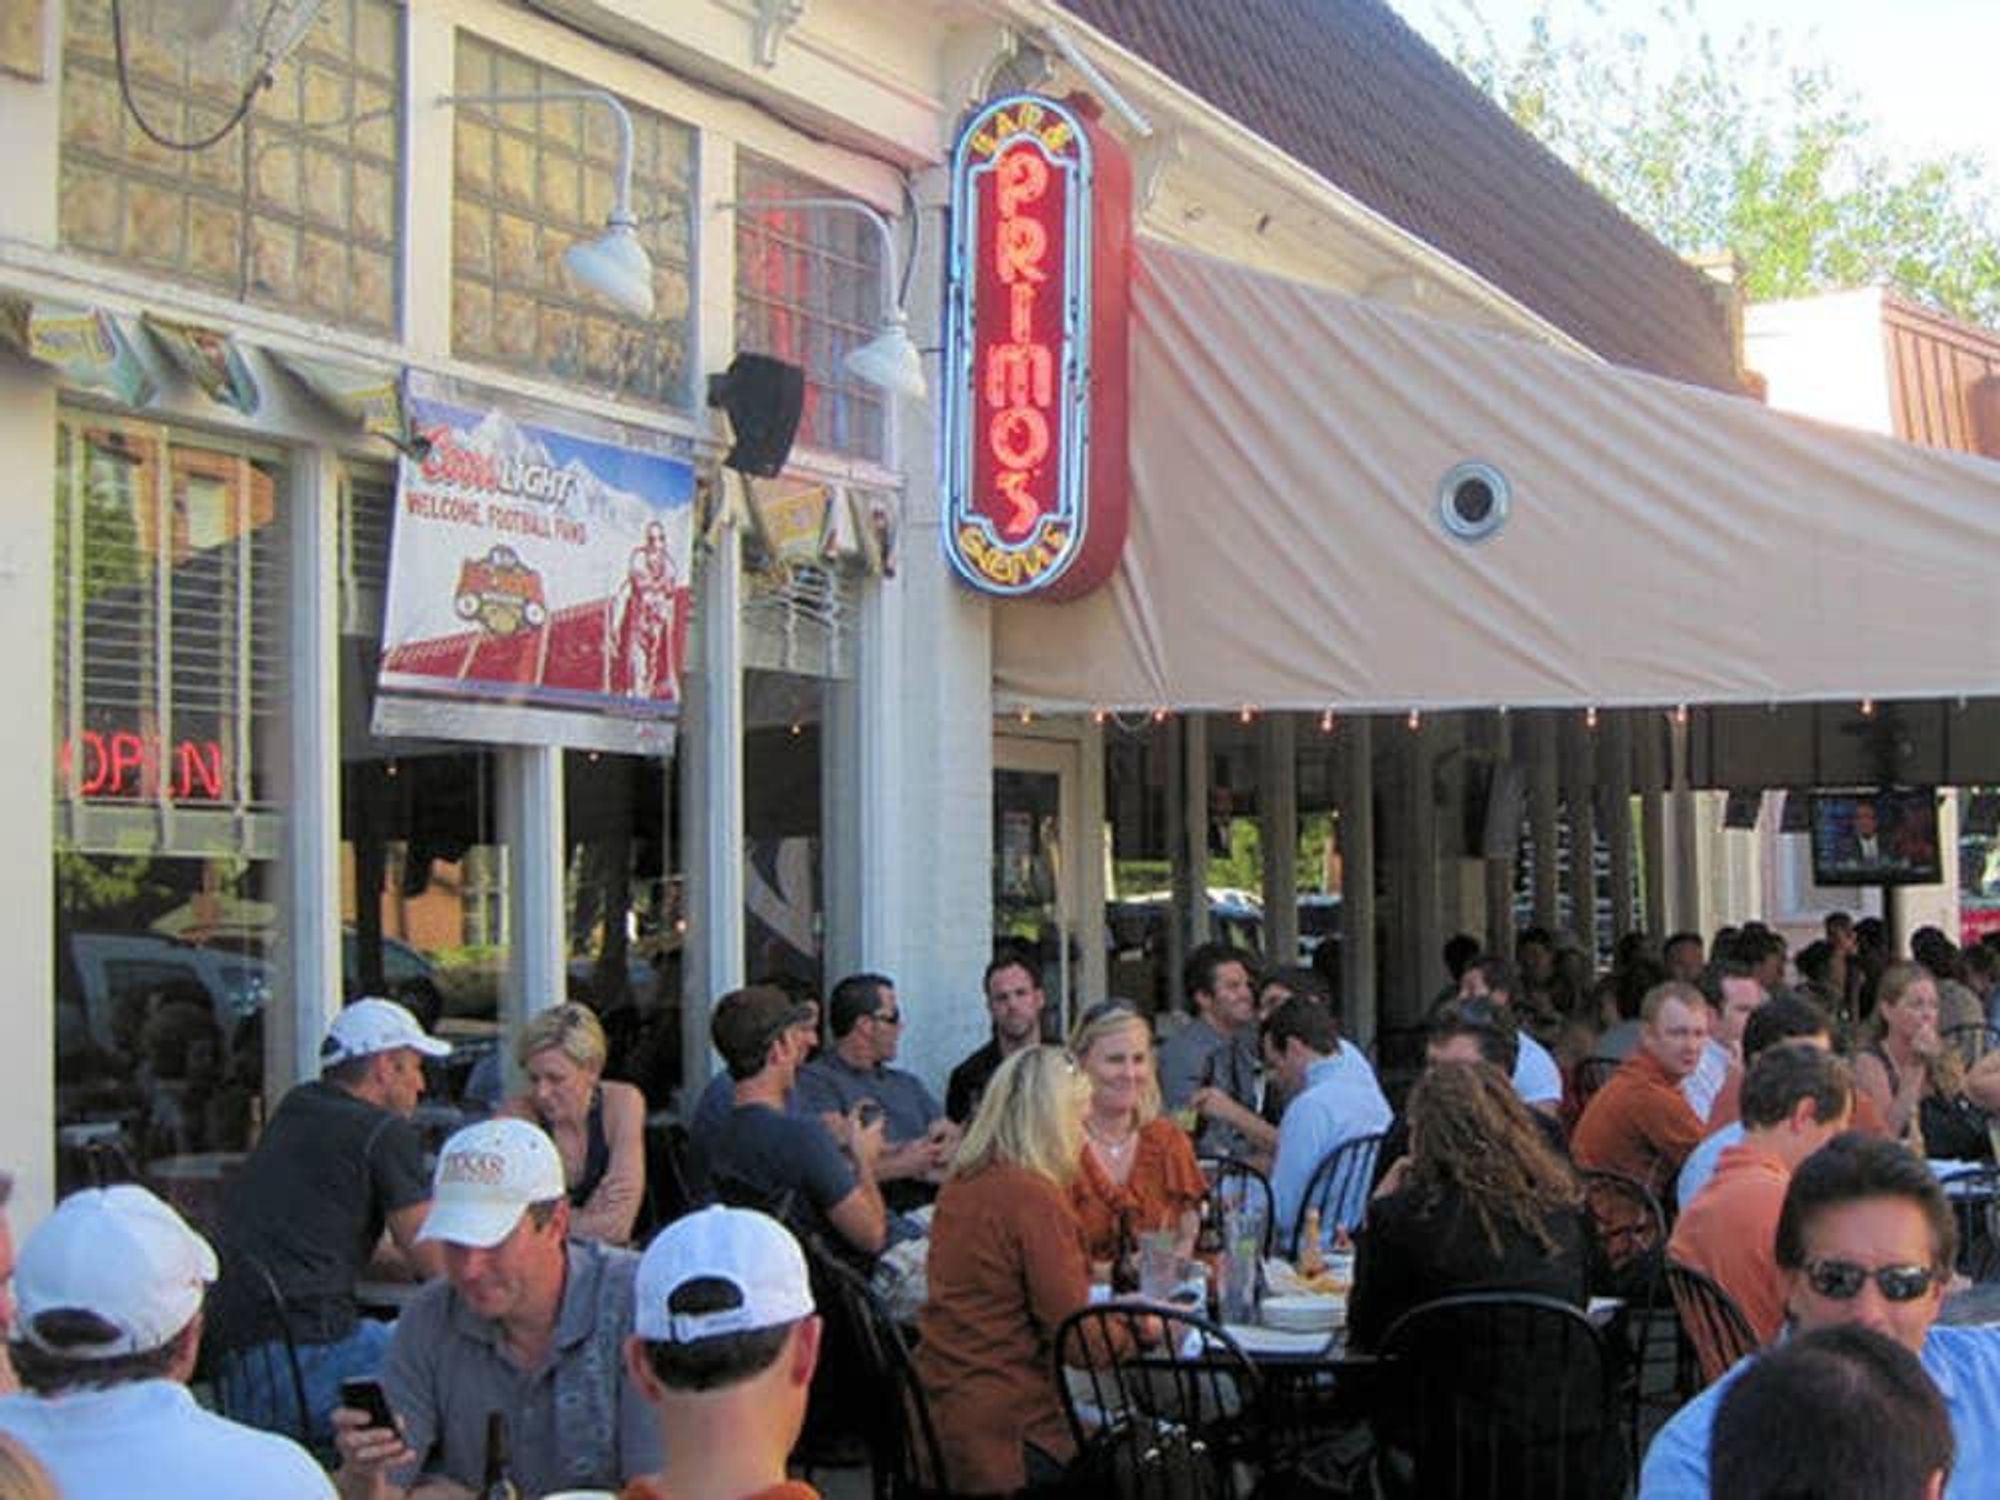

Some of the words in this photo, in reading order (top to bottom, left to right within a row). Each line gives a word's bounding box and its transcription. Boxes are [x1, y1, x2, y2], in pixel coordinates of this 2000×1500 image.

[986, 149, 1053, 534] PRIMO'S
[498, 454, 578, 509] LIGHT
[487, 503, 553, 540] FOOTBALL
[553, 517, 587, 546] FANS
